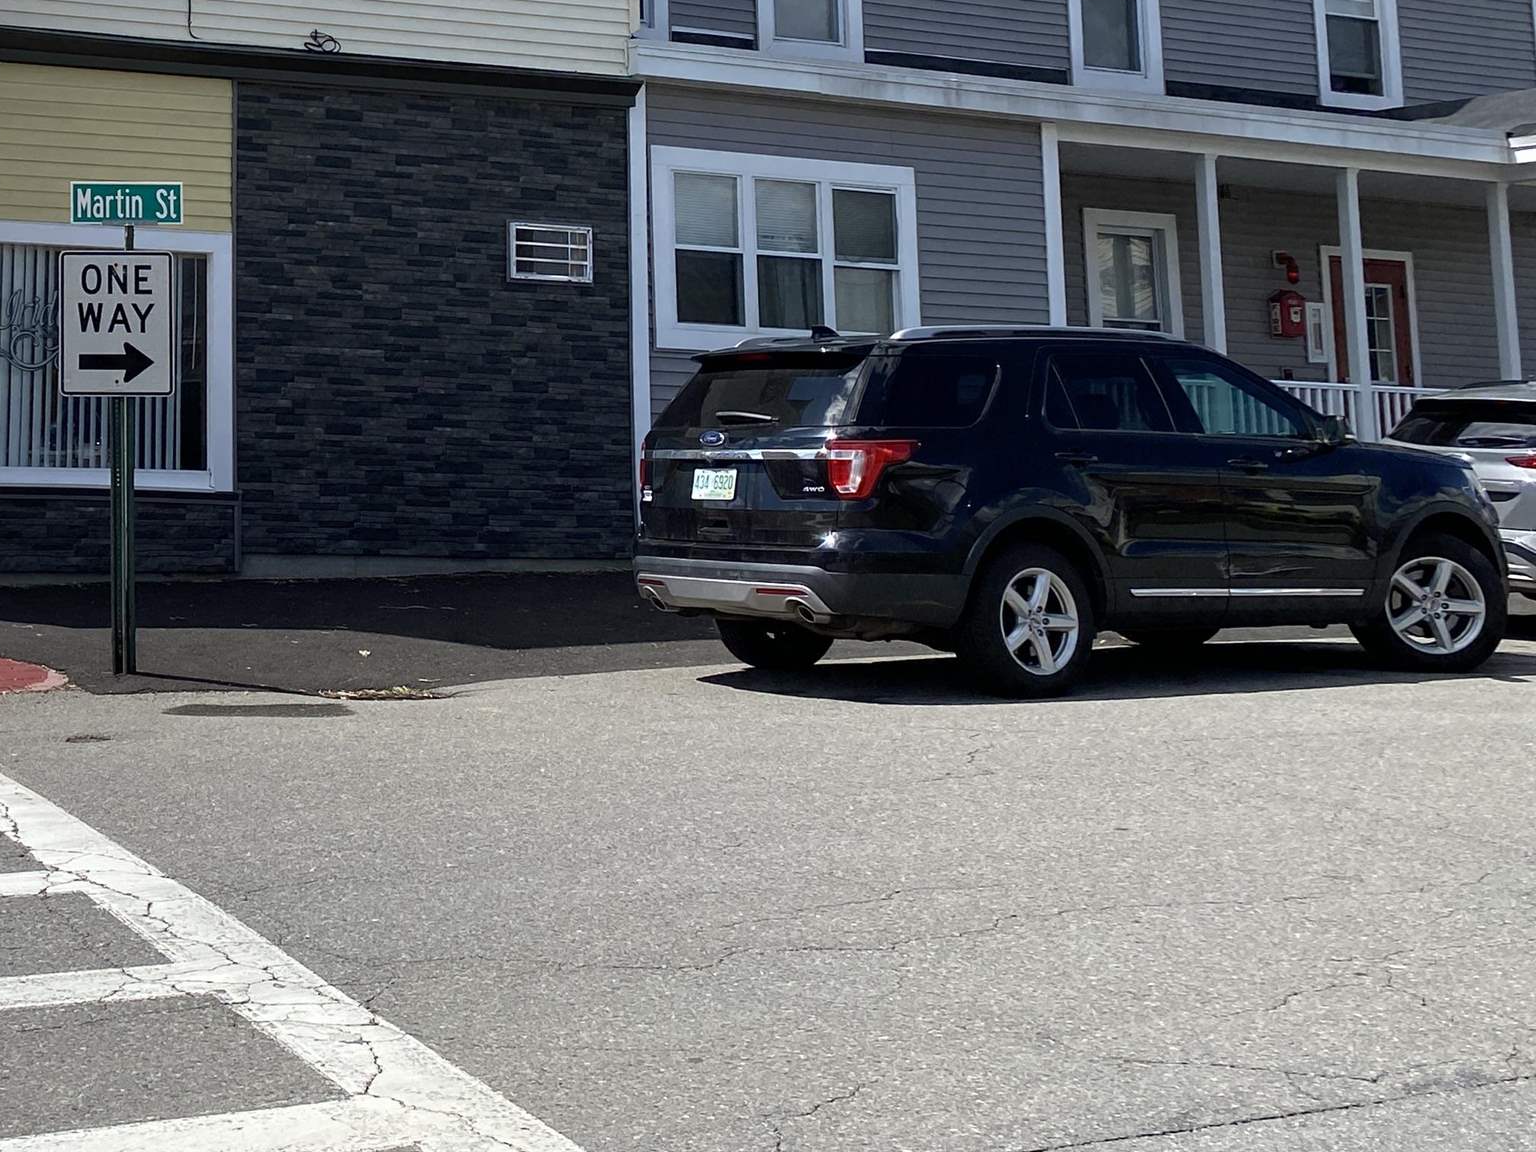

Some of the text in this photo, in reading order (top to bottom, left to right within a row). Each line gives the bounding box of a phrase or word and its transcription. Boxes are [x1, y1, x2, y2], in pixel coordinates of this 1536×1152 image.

[76, 188, 177, 219] Martin St
[81, 264, 153, 295] ONE
[78, 302, 155, 334] WAY
[695, 475, 734, 490] 434 6920
